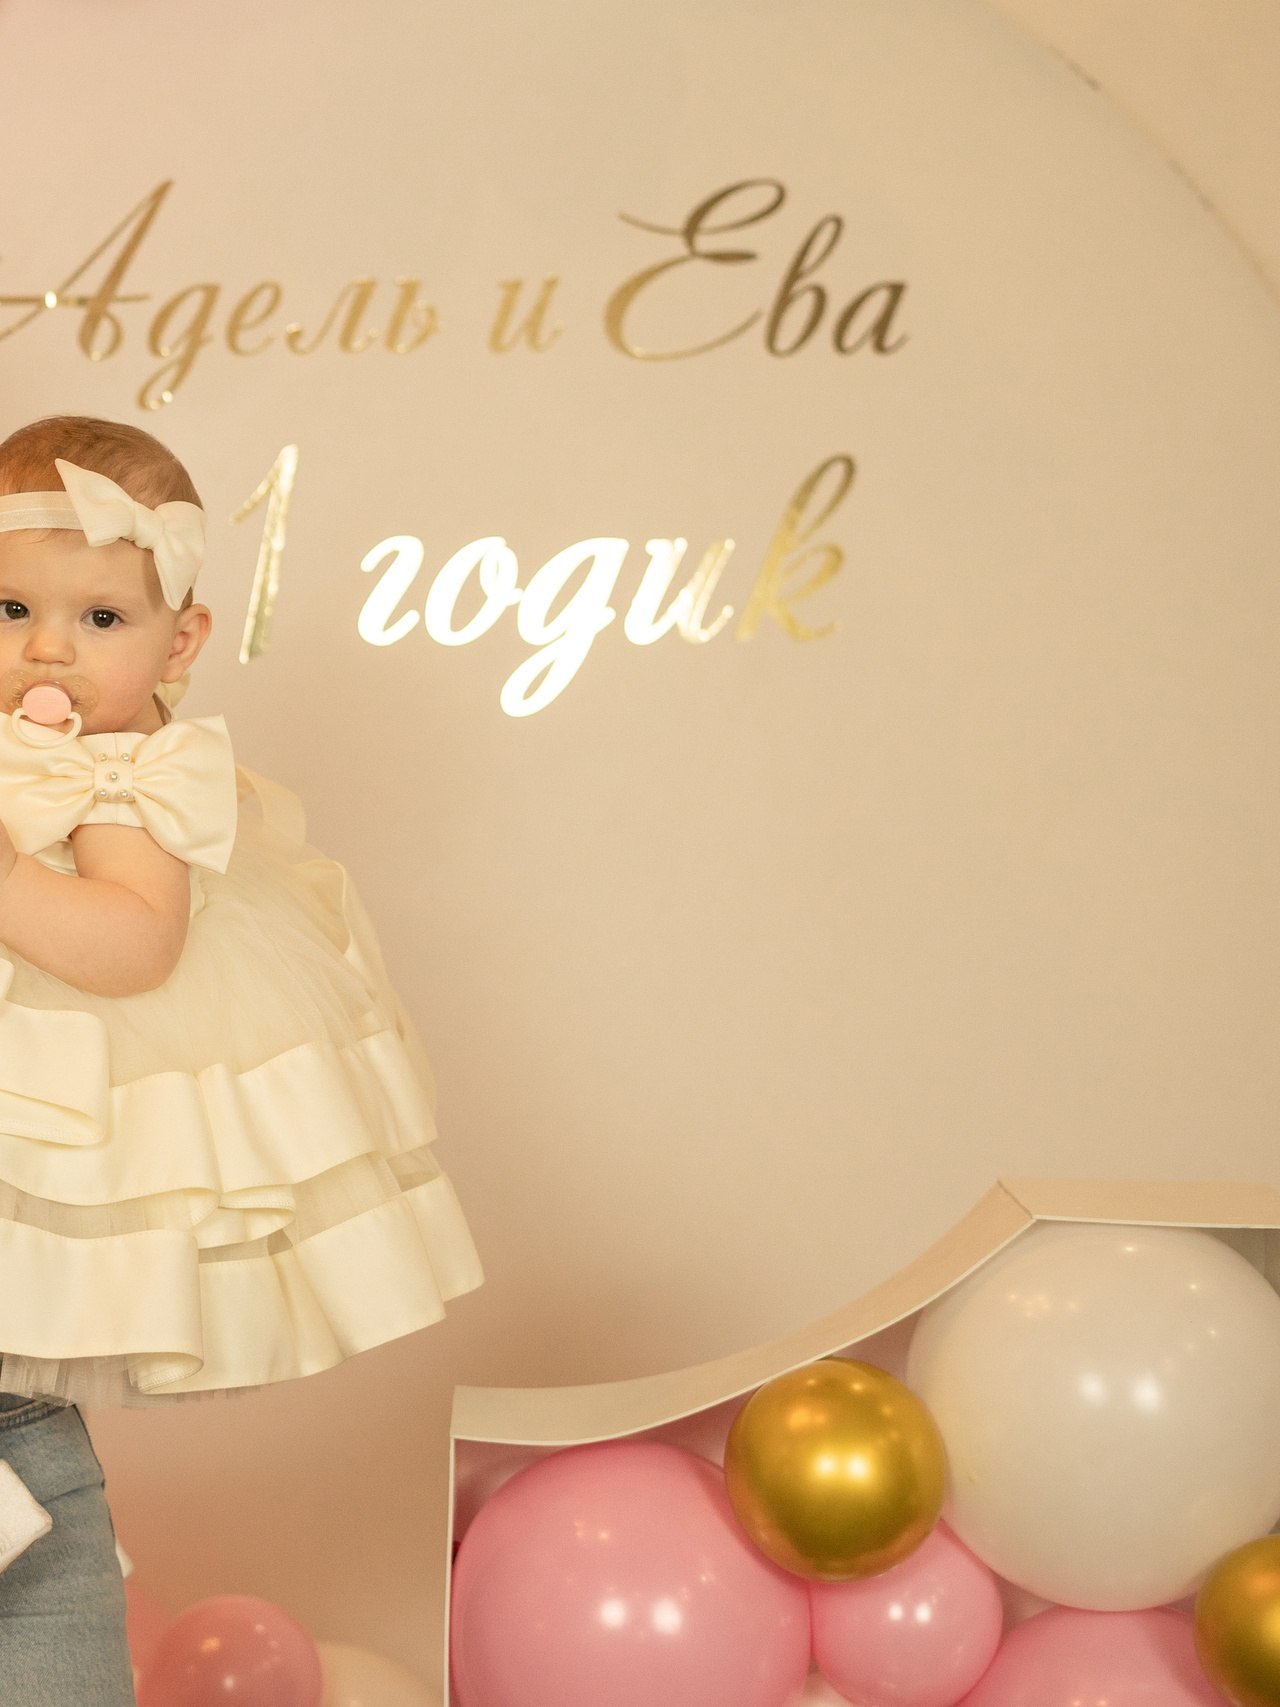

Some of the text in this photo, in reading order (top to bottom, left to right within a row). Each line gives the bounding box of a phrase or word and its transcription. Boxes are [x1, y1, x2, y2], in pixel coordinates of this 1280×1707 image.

[487, 273, 565, 353] и
[604, 178, 910, 360] Ева
[232, 444, 858, 717] 1 годик
